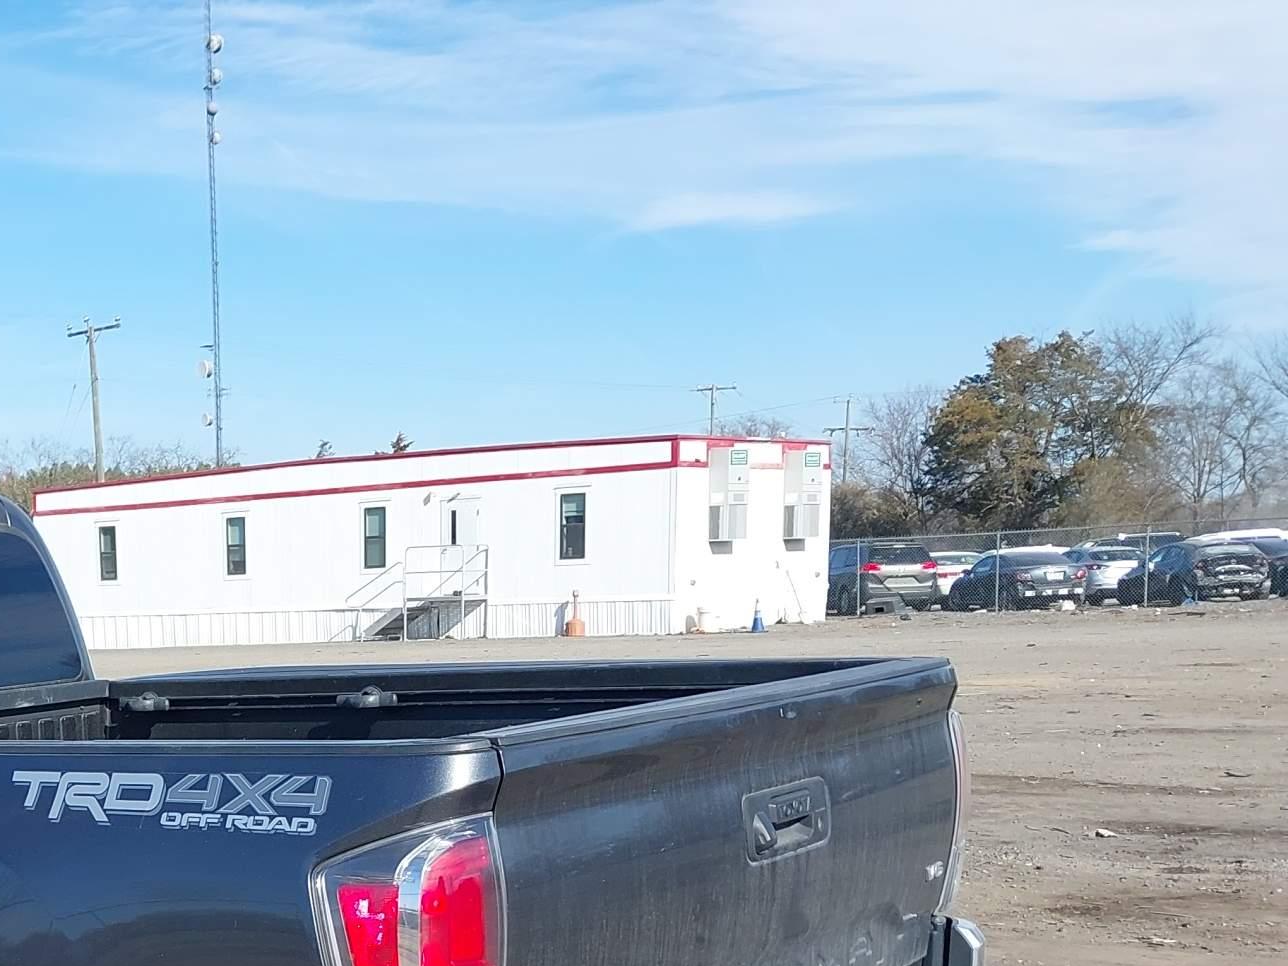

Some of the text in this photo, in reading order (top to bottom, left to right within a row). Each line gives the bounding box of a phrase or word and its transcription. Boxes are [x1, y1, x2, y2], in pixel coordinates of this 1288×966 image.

[12, 771, 333, 826] TRD 4X4
[160, 812, 317, 836] OFF ROAD
[925, 860, 944, 881] V6
